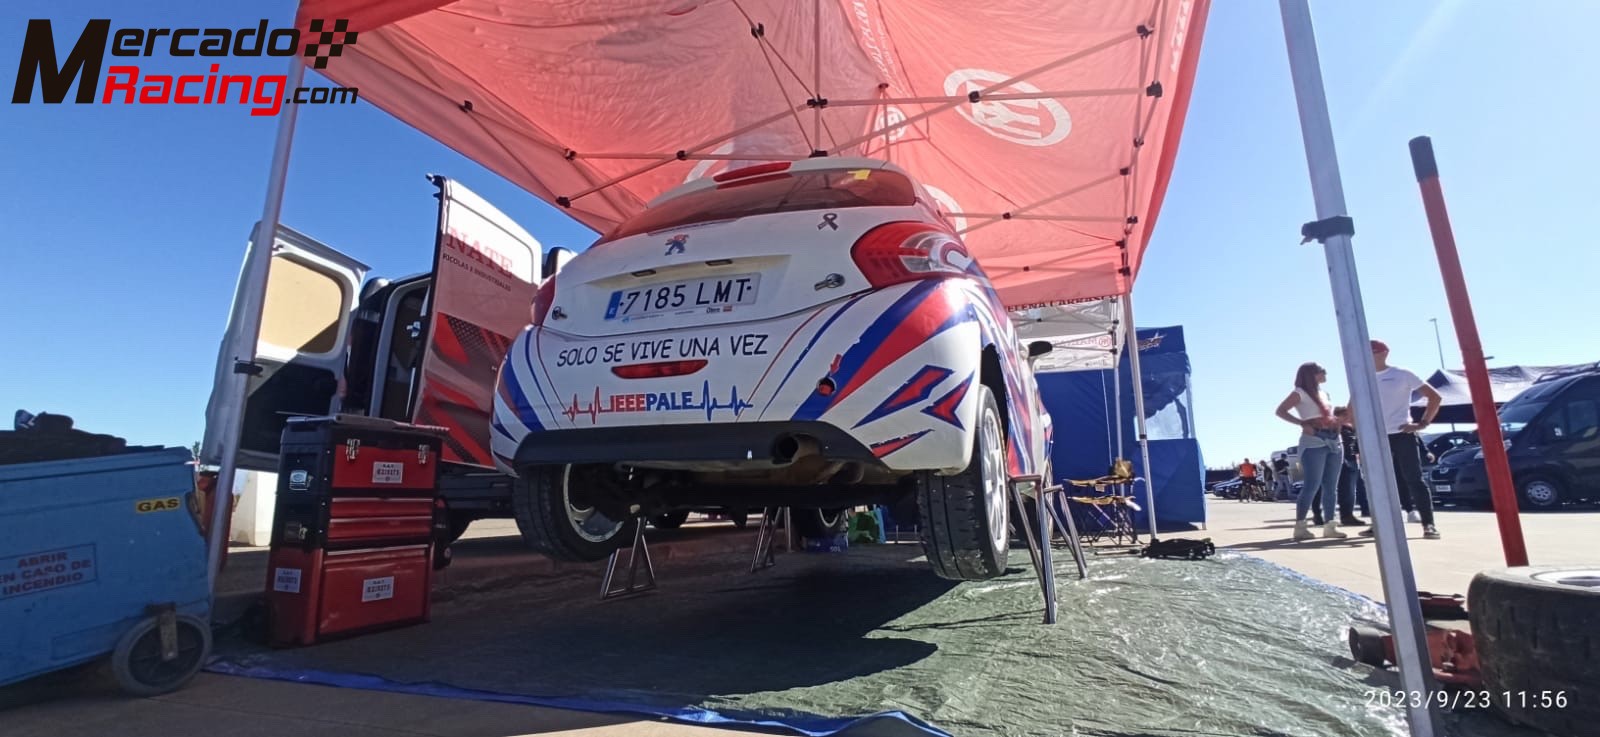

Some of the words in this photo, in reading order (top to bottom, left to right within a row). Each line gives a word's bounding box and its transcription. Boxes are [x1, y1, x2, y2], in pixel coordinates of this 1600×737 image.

[623, 284, 686, 315] 7185
[695, 278, 751, 305] LMT
[557, 346, 597, 367] SOLO
[603, 342, 625, 362] SE
[631, 338, 674, 360] VIVE
[679, 337, 720, 357] UNA
[730, 334, 768, 355] VEZ
[137, 498, 179, 513] GAS
[17, 551, 68, 568] ABRIR
[21, 562, 66, 579] CASO
[71, 559, 92, 571] DE
[3, 571, 84, 595] INCENDIO
